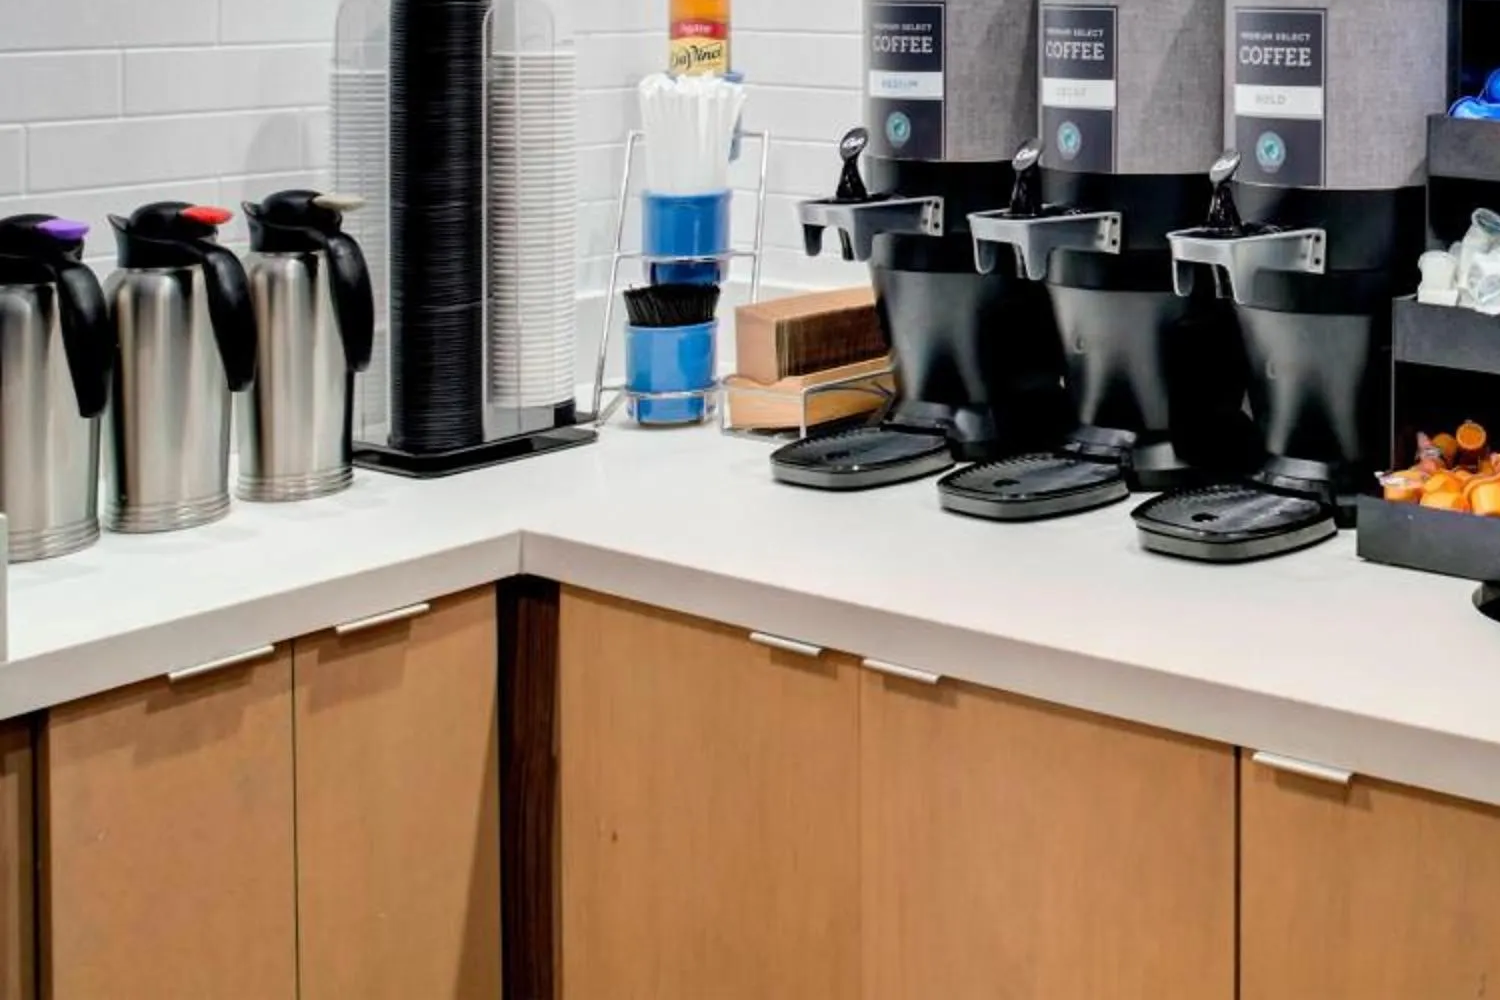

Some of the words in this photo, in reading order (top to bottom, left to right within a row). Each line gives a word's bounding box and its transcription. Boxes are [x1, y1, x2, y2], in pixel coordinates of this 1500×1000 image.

[872, 35, 933, 53] COFFEE
[1045, 40, 1105, 61] COFFEE
[1239, 45, 1312, 67] COFFEE
